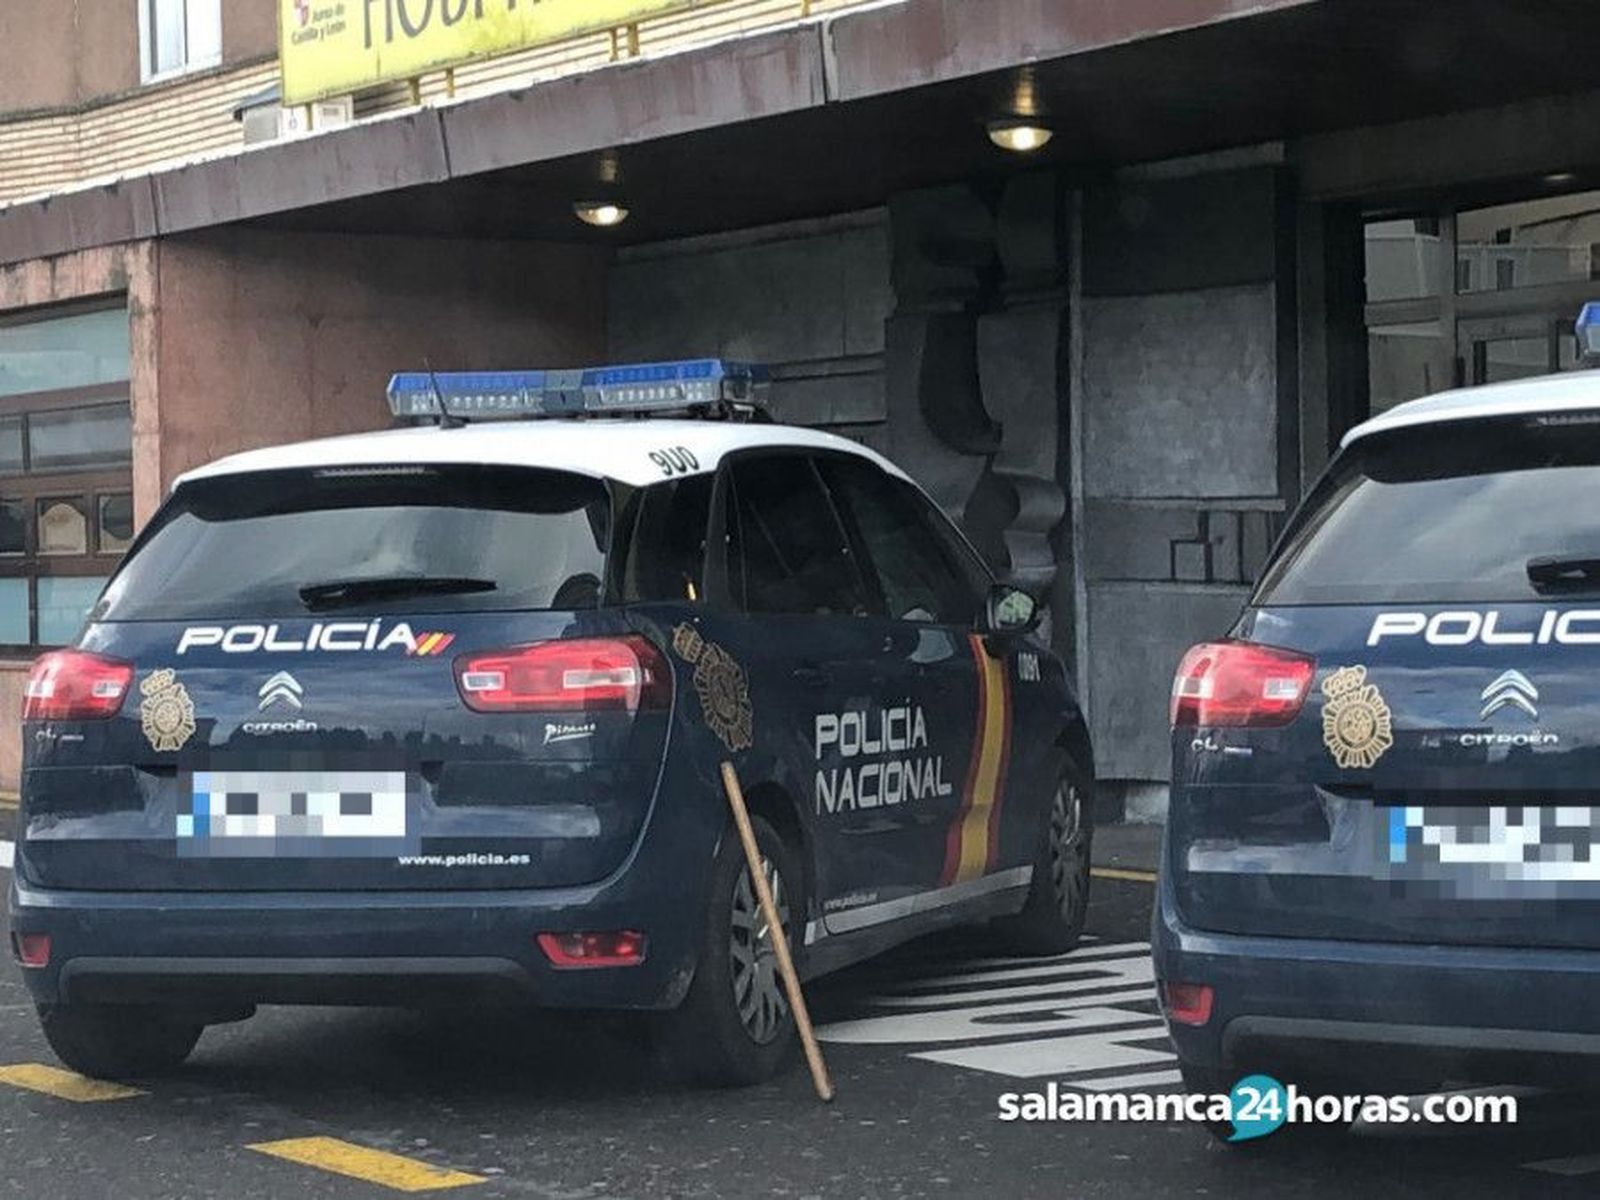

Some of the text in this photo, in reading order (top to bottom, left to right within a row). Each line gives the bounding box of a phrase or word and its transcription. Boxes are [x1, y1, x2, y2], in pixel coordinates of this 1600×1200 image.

[176, 618, 417, 655] POLICÍA
[815, 697, 928, 760] POLICÍA
[815, 755, 953, 816] NACIONAL
[398, 852, 531, 868] www.policia.es
